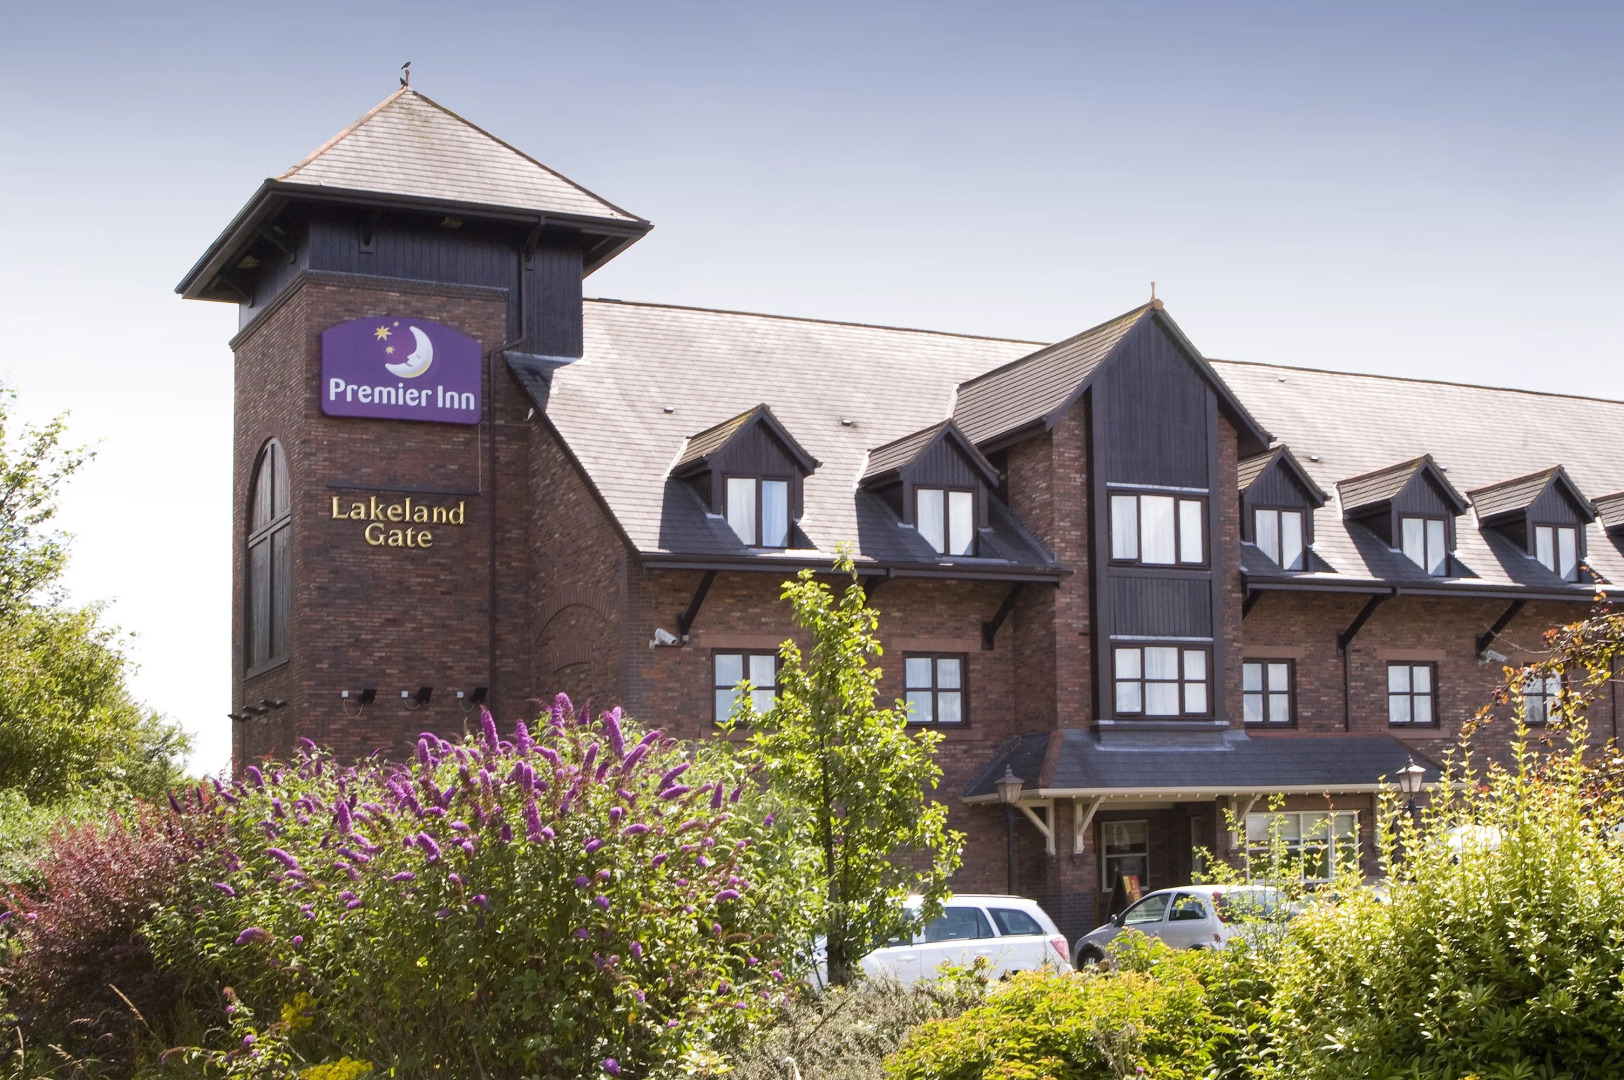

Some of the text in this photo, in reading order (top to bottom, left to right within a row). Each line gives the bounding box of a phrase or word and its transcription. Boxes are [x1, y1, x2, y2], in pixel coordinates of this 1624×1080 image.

[329, 378, 475, 410] Premier Inn
[331, 495, 466, 525] Lakeland
[364, 522, 433, 548] Gate
